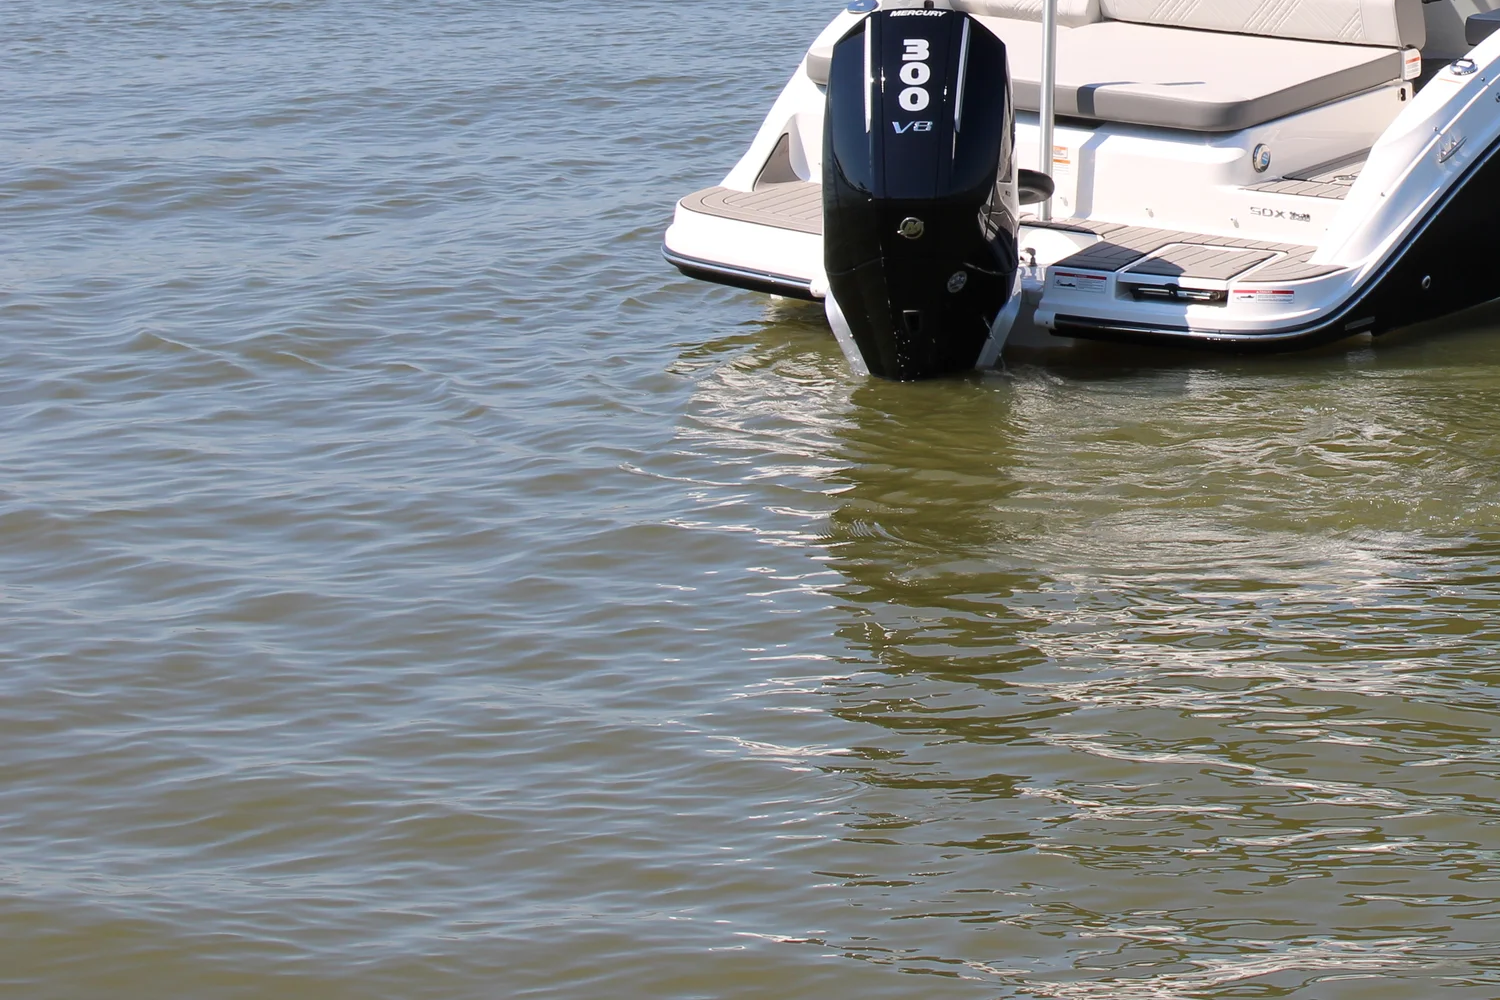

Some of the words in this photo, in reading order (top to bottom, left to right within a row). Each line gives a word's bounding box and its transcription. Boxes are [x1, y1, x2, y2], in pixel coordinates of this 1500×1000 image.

[889, 9, 947, 17] MERCURY
[898, 38, 931, 112] 300
[891, 120, 933, 134] V8
[1249, 206, 1286, 220] SDX
